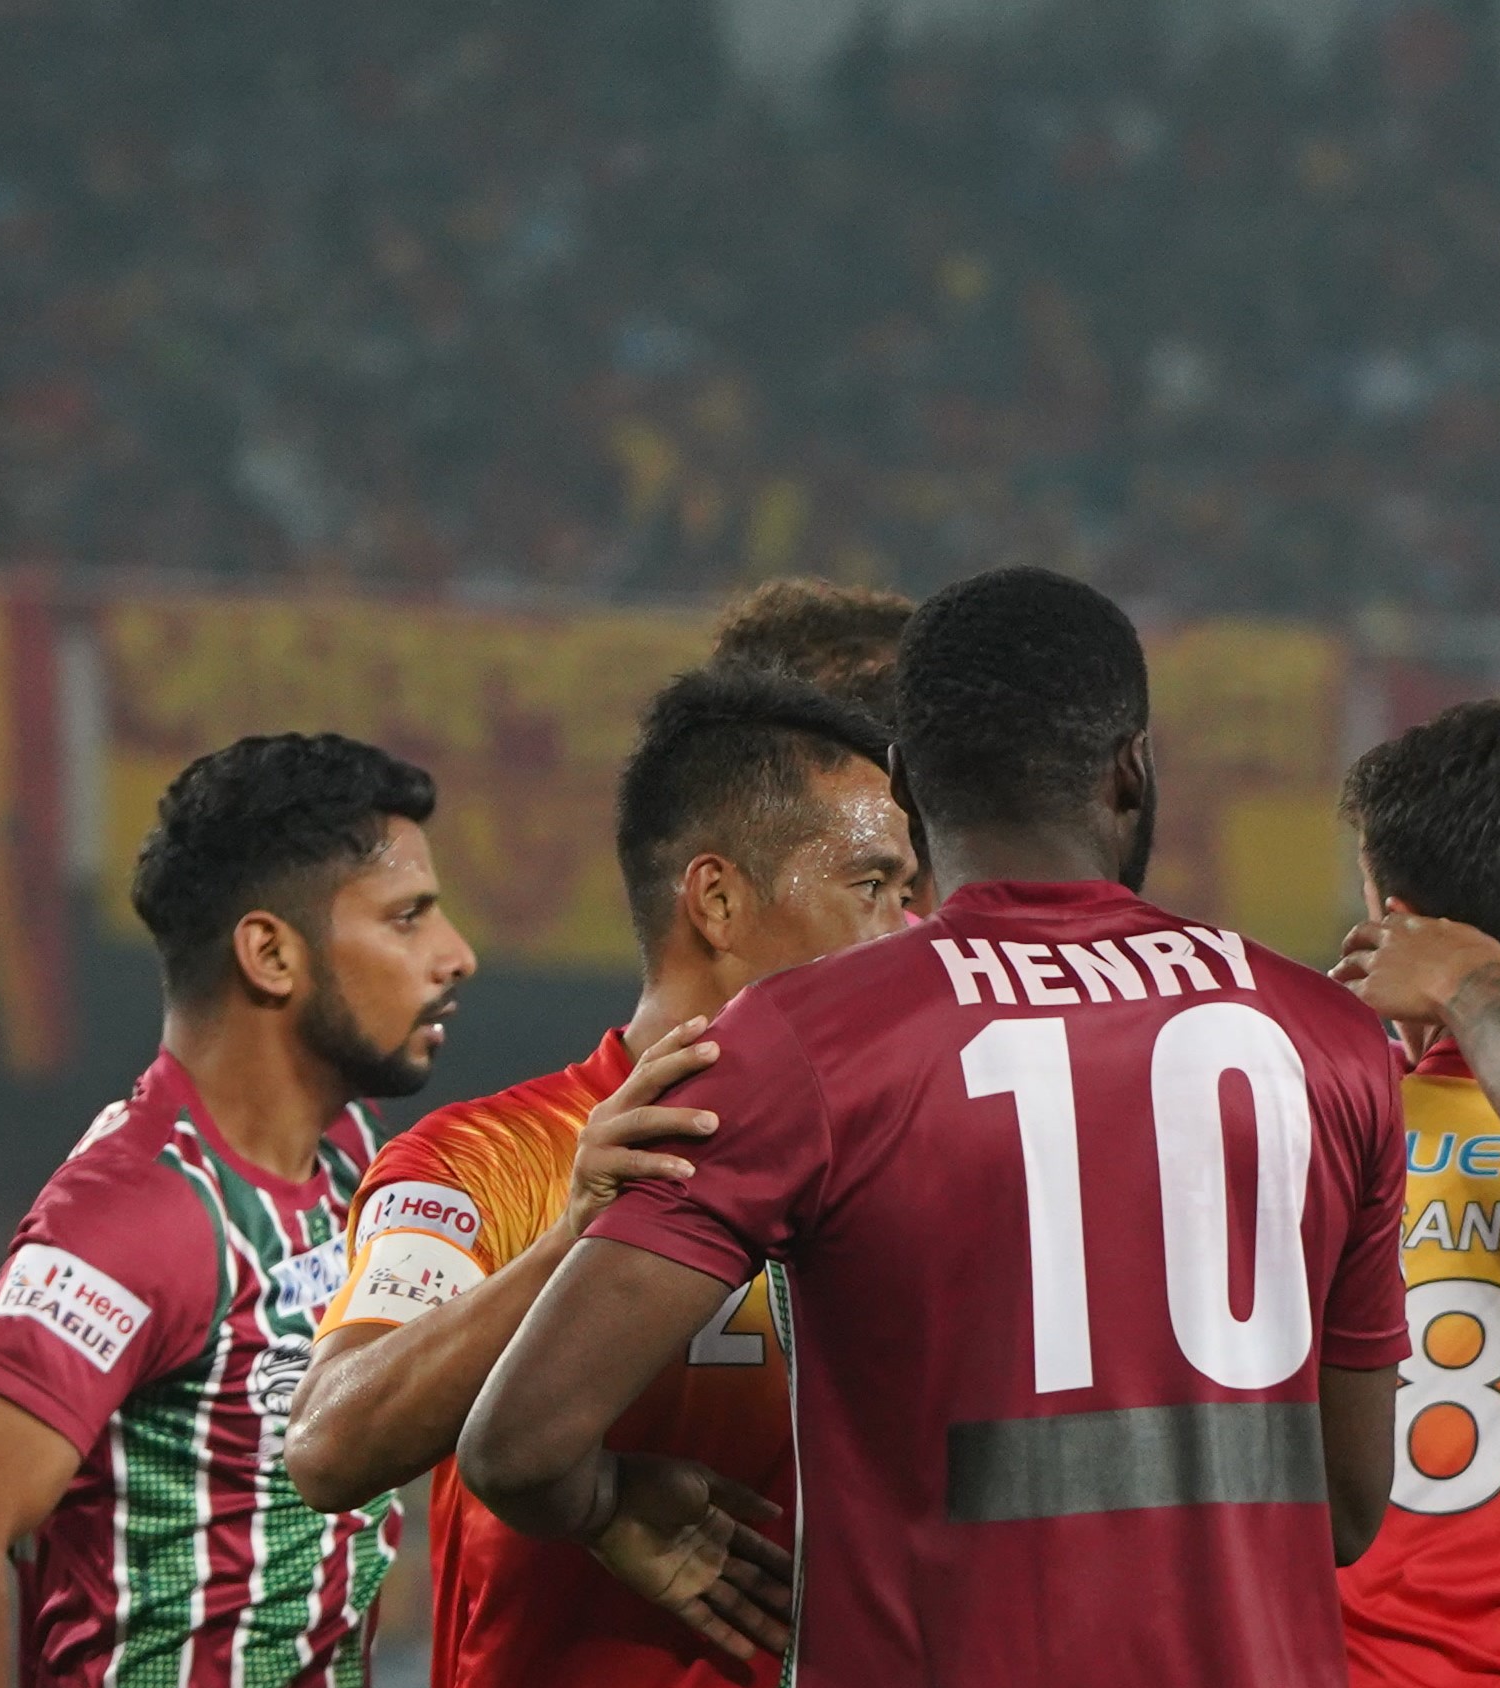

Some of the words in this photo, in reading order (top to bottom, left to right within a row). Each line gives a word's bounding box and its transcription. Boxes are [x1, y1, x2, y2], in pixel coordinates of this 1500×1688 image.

[931, 926, 1257, 1006] HENRY
[401, 1197, 476, 1234] Hero
[959, 1002, 1312, 1394] 10
[2, 1286, 117, 1362] I-LEAGUE
[75, 1283, 135, 1335] Hero
[369, 1281, 445, 1307] I-LEA
